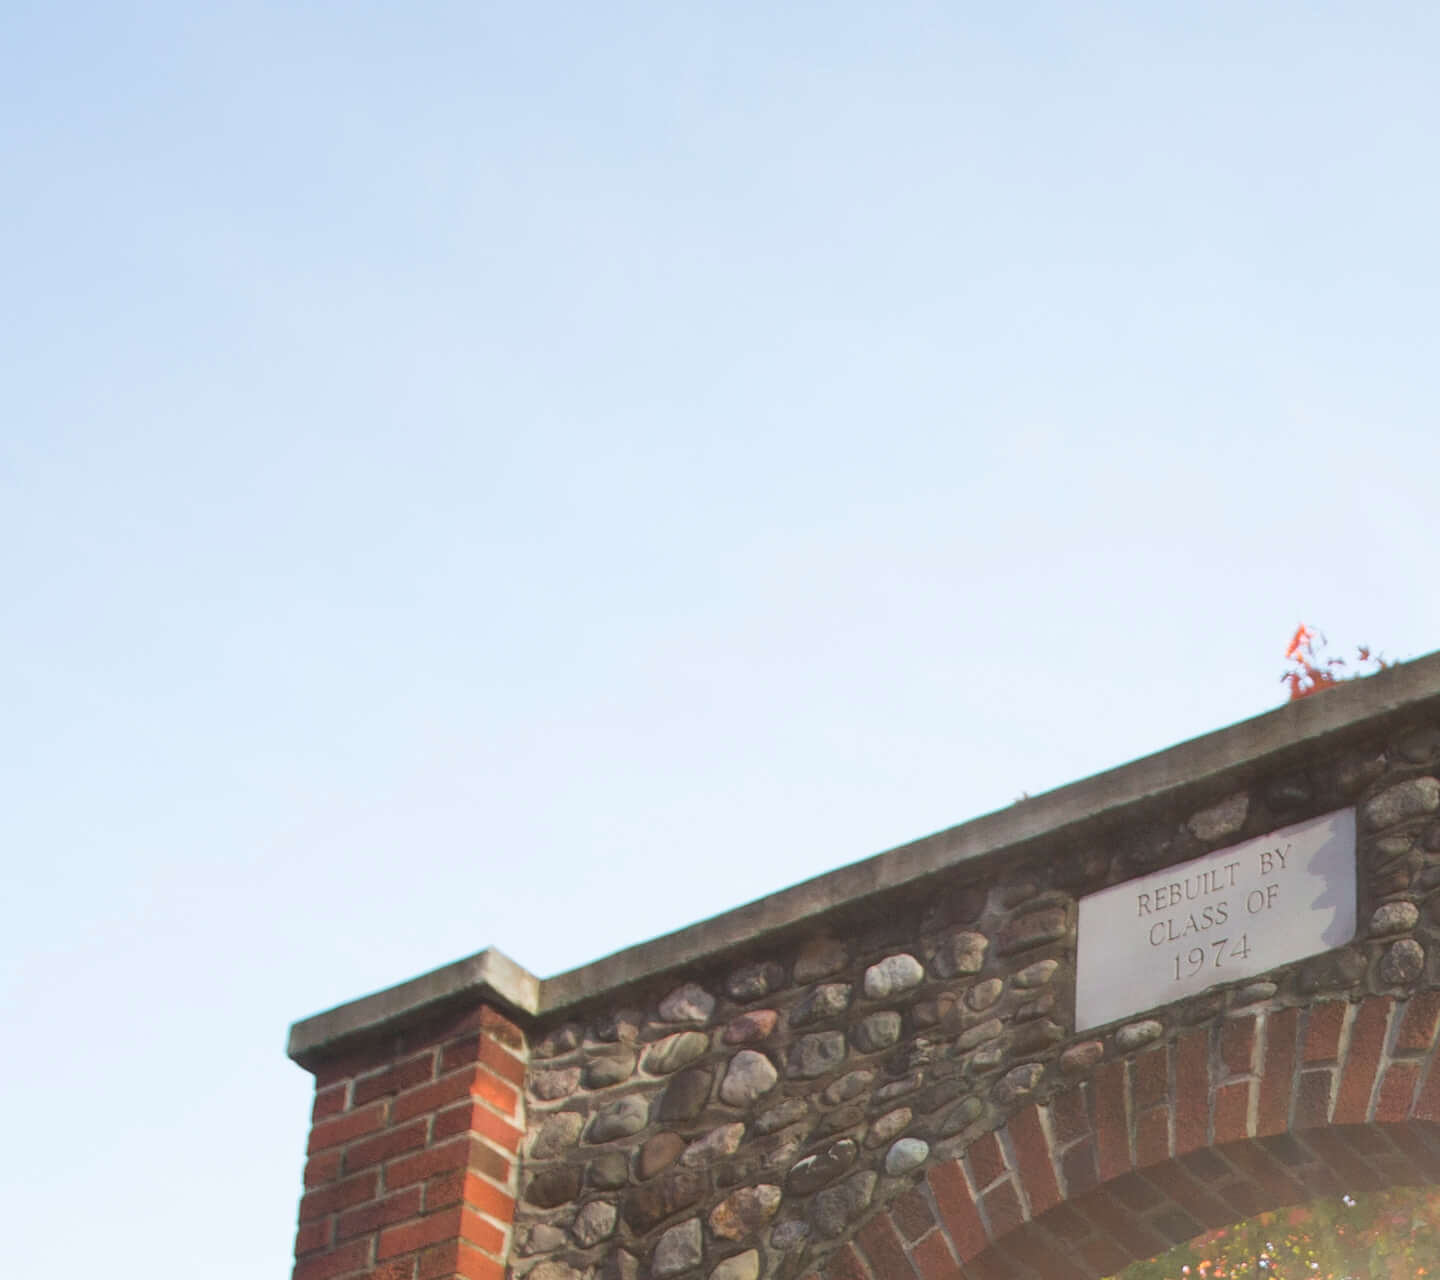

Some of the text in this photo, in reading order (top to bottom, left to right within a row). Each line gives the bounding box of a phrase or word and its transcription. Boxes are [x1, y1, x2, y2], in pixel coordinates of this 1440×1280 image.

[1136, 843, 1292, 917] REBUILT BY
[1149, 884, 1279, 946] CLASS OF
[1174, 932, 1252, 981] 1974
